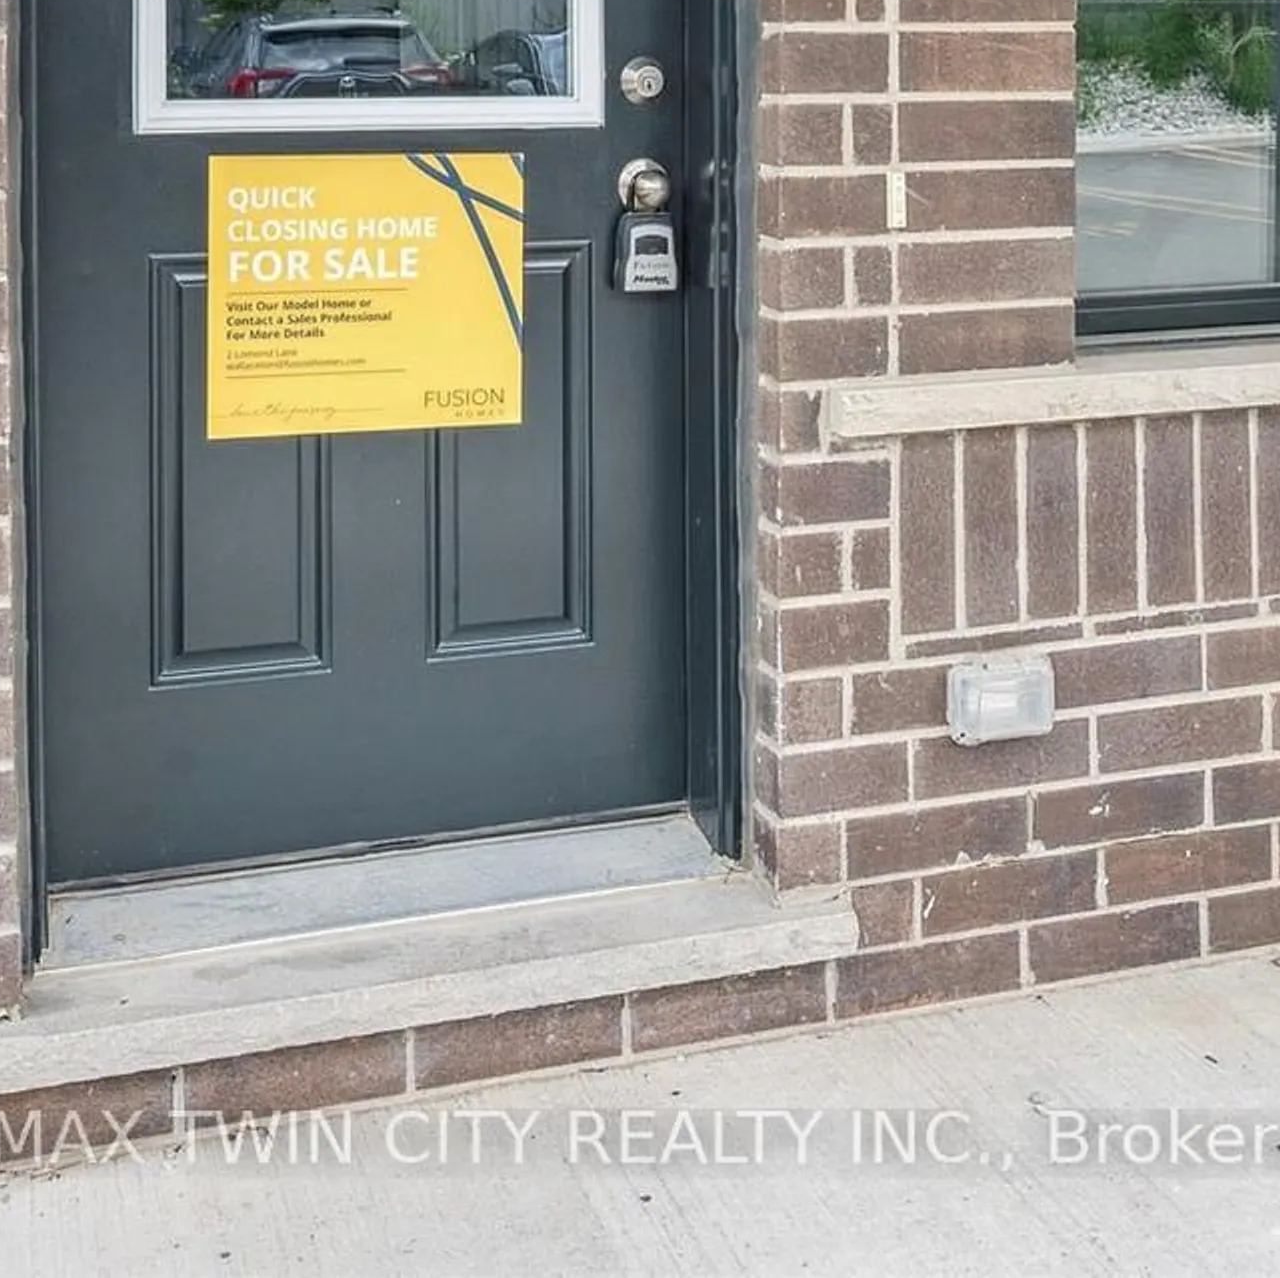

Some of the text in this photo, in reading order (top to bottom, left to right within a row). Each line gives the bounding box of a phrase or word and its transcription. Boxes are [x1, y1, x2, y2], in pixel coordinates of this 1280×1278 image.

[228, 186, 315, 213] QUICK
[228, 216, 438, 242] CLOSING HOME
[228, 247, 420, 283] FOR SALE
[225, 299, 372, 312] Visit Our Model Home or
[226, 310, 392, 327] Contact a Sales Professional
[226, 326, 325, 340] For More Details
[424, 387, 505, 408] FUSION
